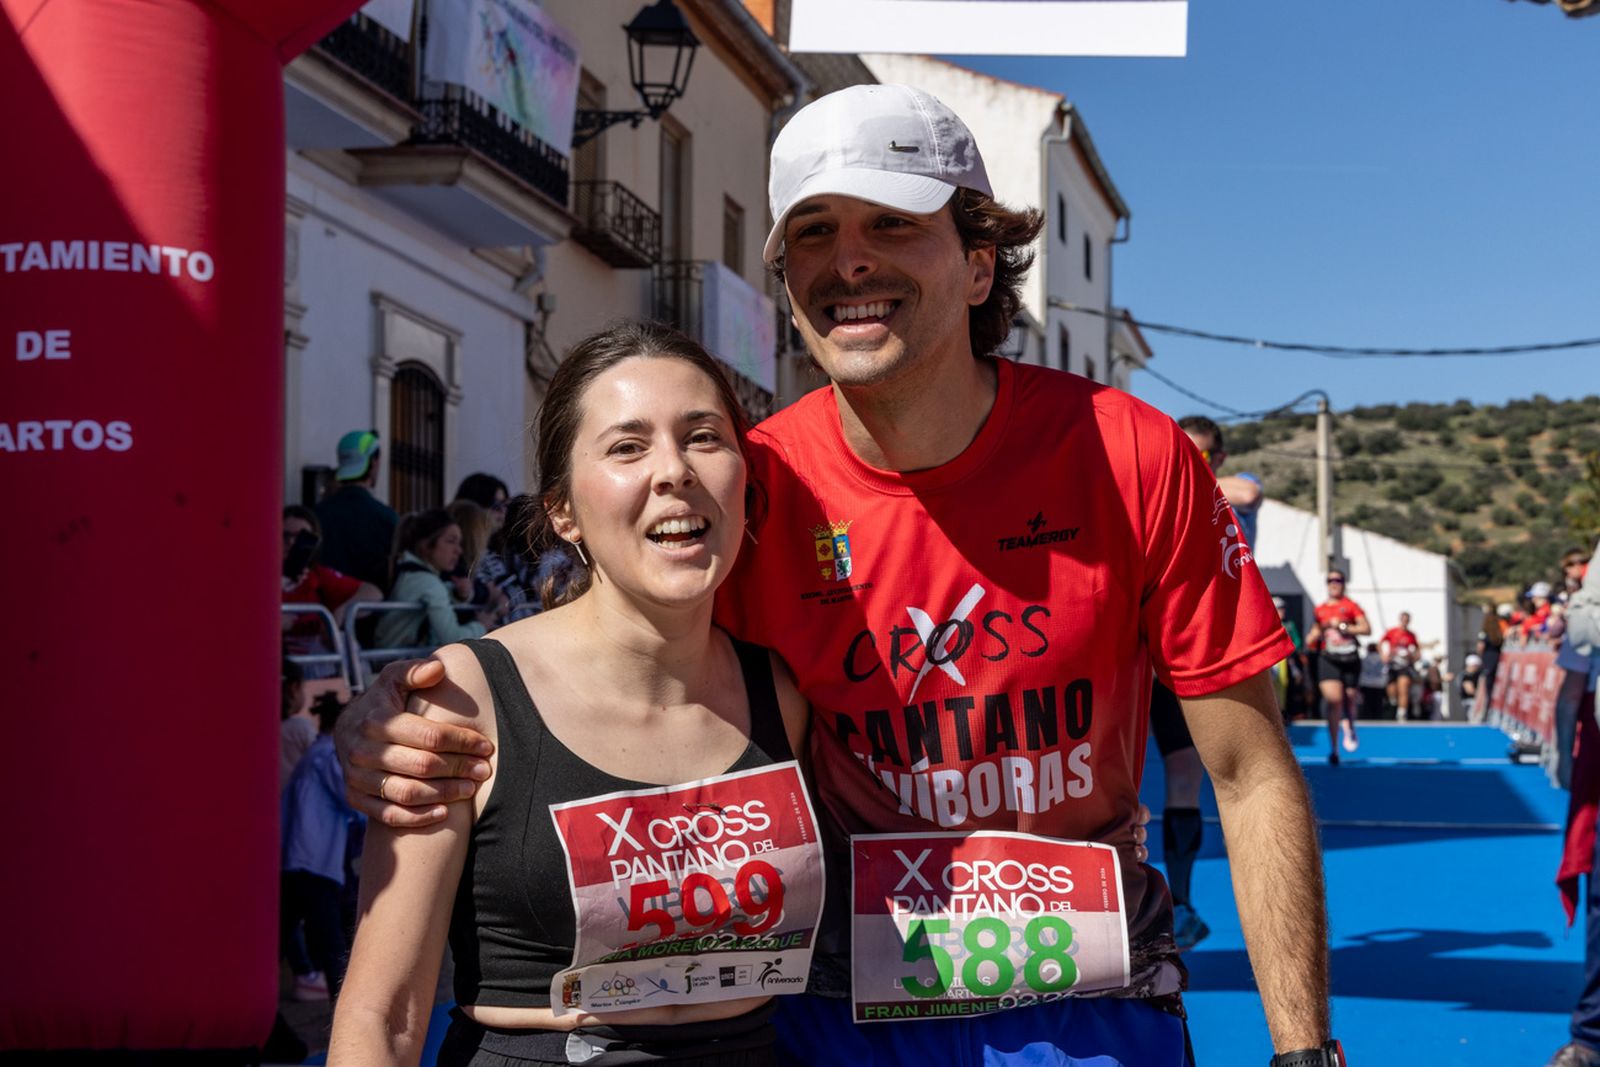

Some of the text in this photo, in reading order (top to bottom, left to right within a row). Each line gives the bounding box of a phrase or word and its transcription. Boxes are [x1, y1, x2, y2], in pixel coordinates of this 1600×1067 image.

[16, 329, 71, 361] DE
[997, 527, 1080, 552] TEAMERGY
[843, 605, 1051, 682] CROSS
[595, 800, 771, 856] X CROSS
[610, 839, 779, 890] PANTANO DEL
[892, 849, 1074, 894] X CROSS
[893, 892, 1077, 922] PANTANO DEL
[901, 915, 1078, 998] 588
[864, 1005, 919, 1019] FRAN
